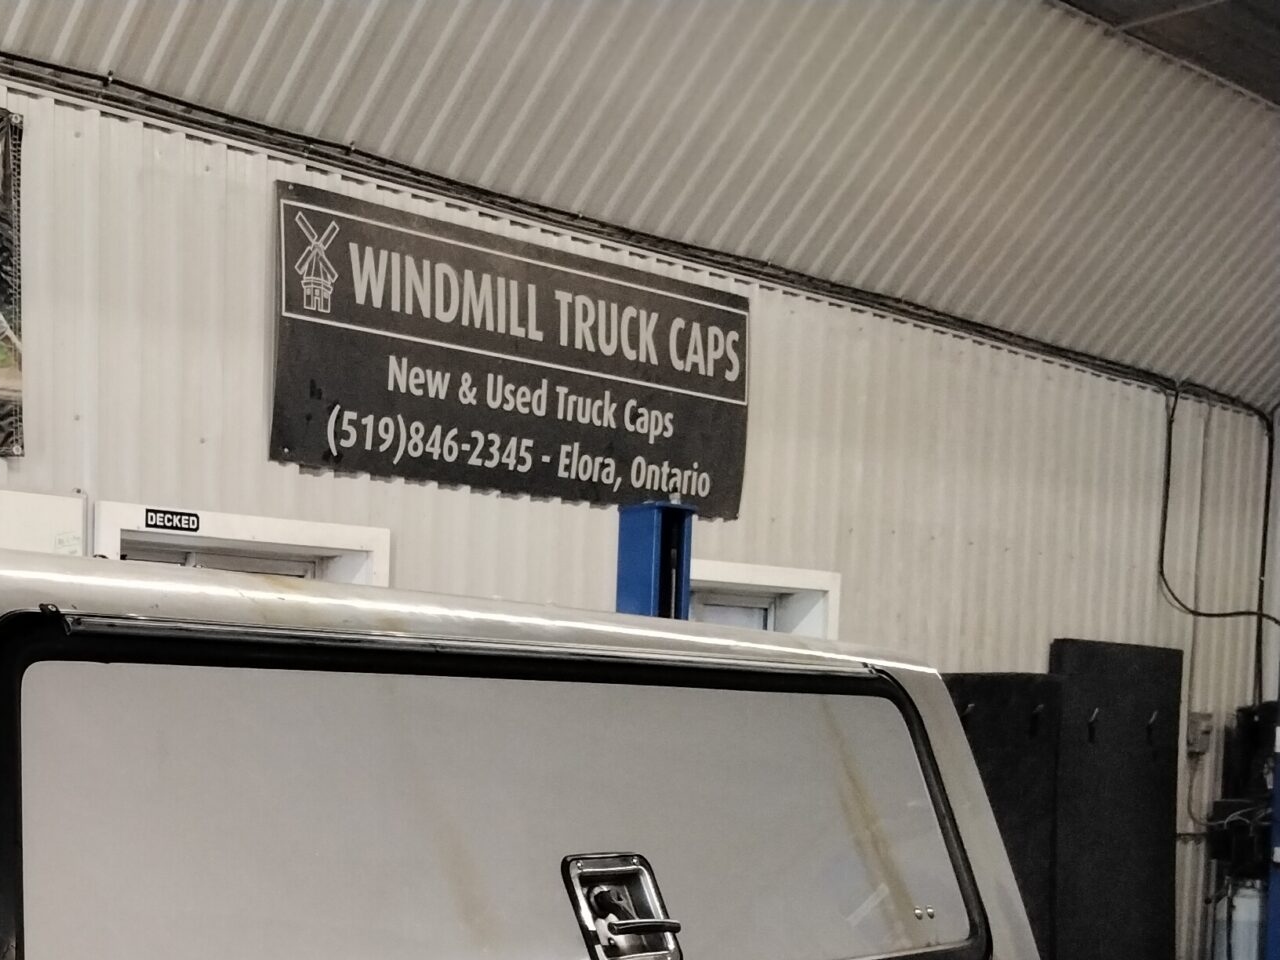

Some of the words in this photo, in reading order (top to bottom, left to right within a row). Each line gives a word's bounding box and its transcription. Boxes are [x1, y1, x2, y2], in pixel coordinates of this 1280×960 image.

[348, 242, 544, 342] WINDMILL
[554, 290, 659, 366] TRUCK
[669, 317, 740, 382] CAPS
[387, 355, 451, 400] New
[458, 372, 478, 406] &
[486, 373, 548, 417] Used
[555, 386, 617, 429] Truck
[624, 399, 674, 445] Caps
[327, 404, 534, 473] (519)846-2345
[557, 442, 622, 492] Elora,
[630, 455, 711, 498] Ontario
[147, 512, 198, 529] DECKED
